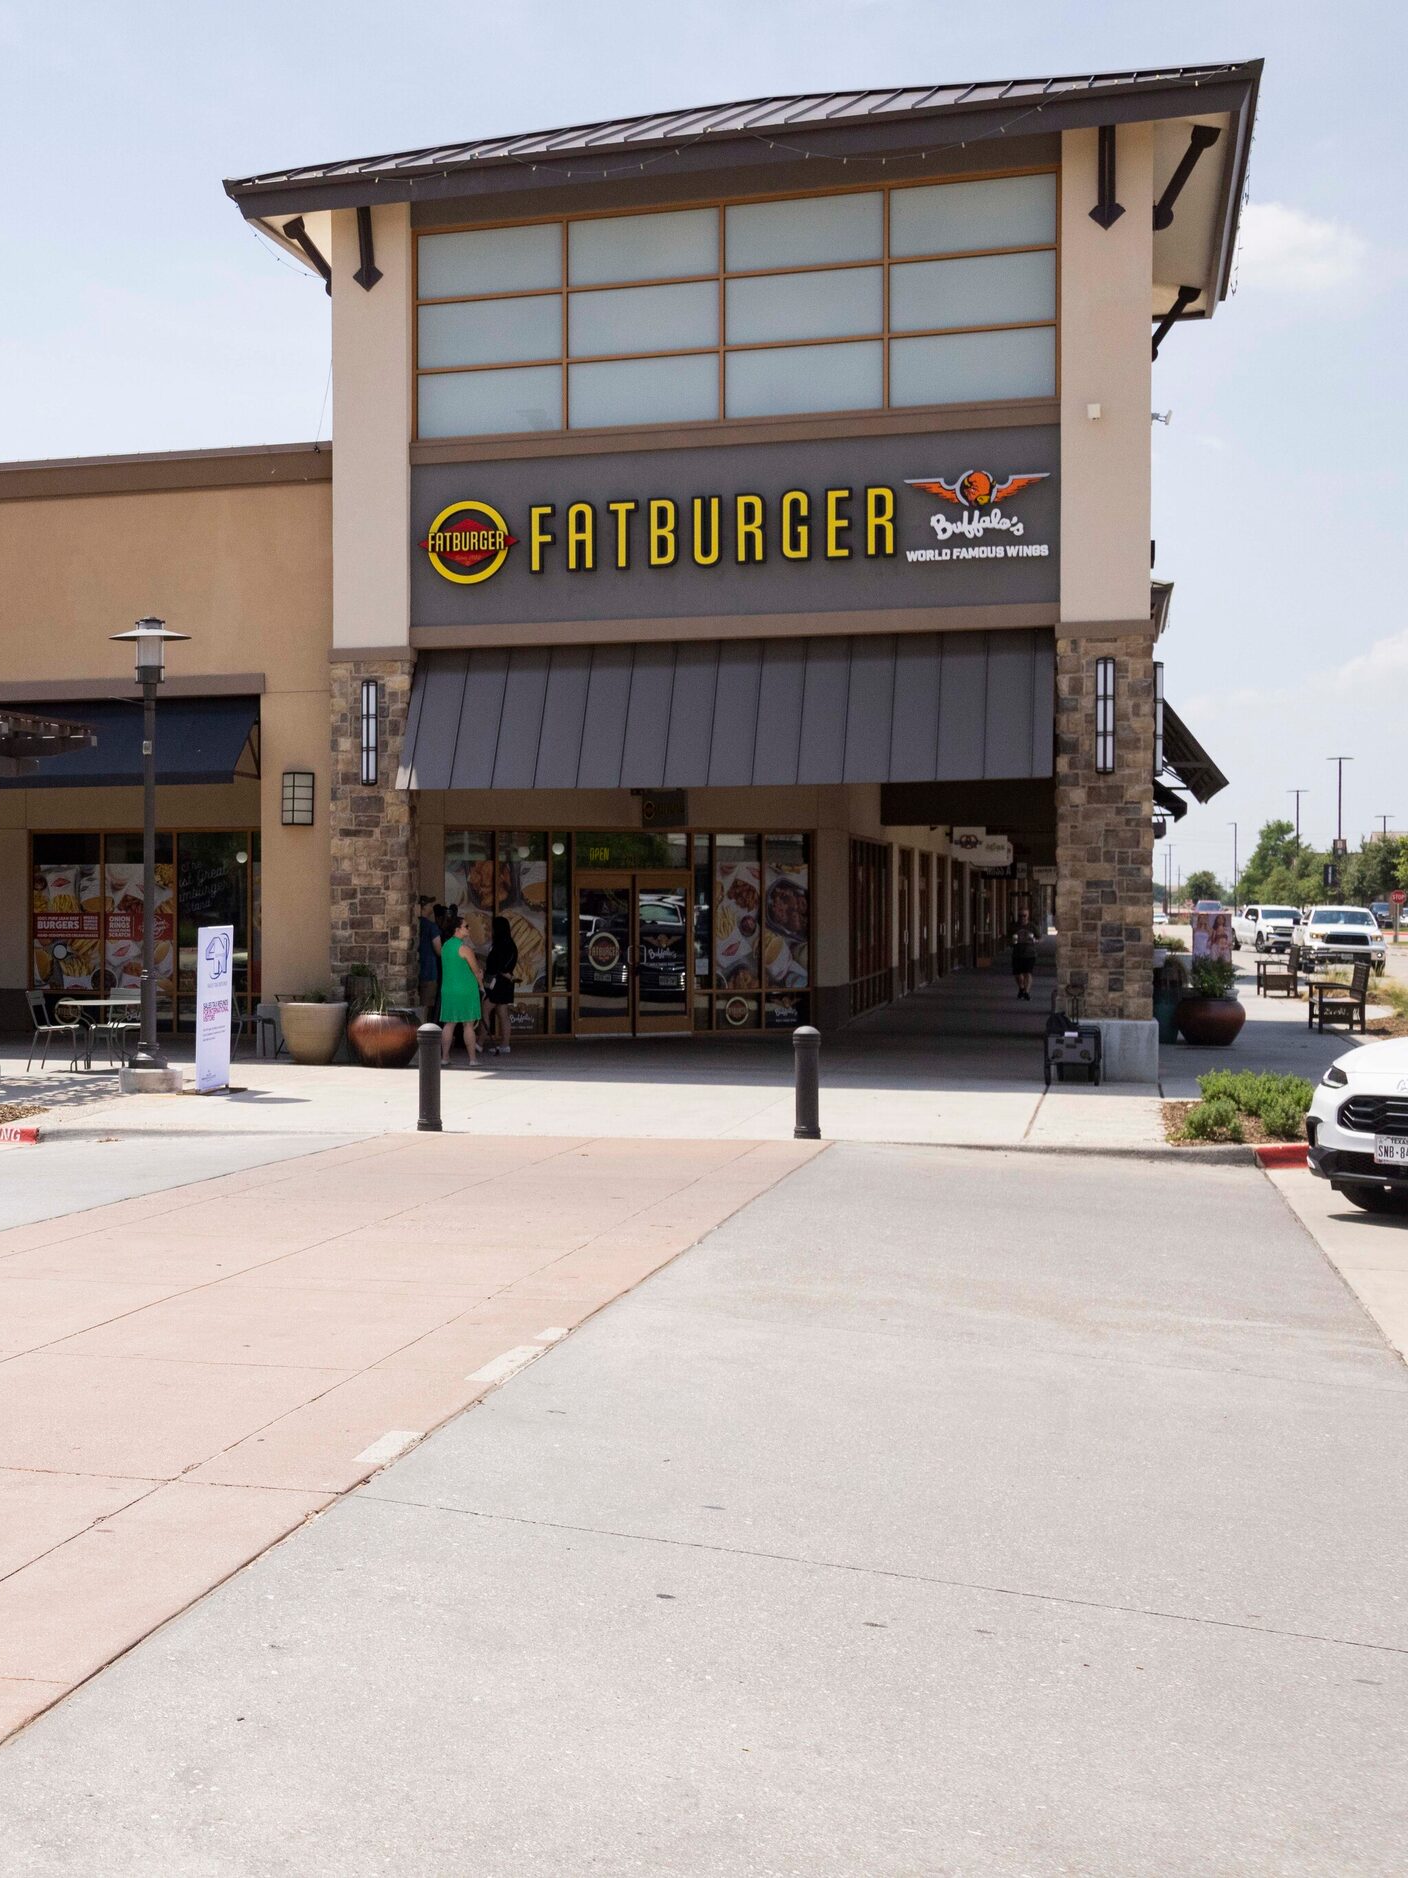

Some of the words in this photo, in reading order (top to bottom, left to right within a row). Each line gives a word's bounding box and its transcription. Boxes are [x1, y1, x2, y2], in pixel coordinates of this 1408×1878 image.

[529, 486, 895, 573] FATBURGER
[930, 508, 1024, 540] Buffalo's
[428, 530, 504, 552] FATBURGER
[906, 548, 950, 562] WORLD
[953, 545, 1004, 560] FAMOUS
[1006, 544, 1049, 557] WINGS
[589, 847, 610, 861] OPEN
[37, 921, 79, 929] BURGERS
